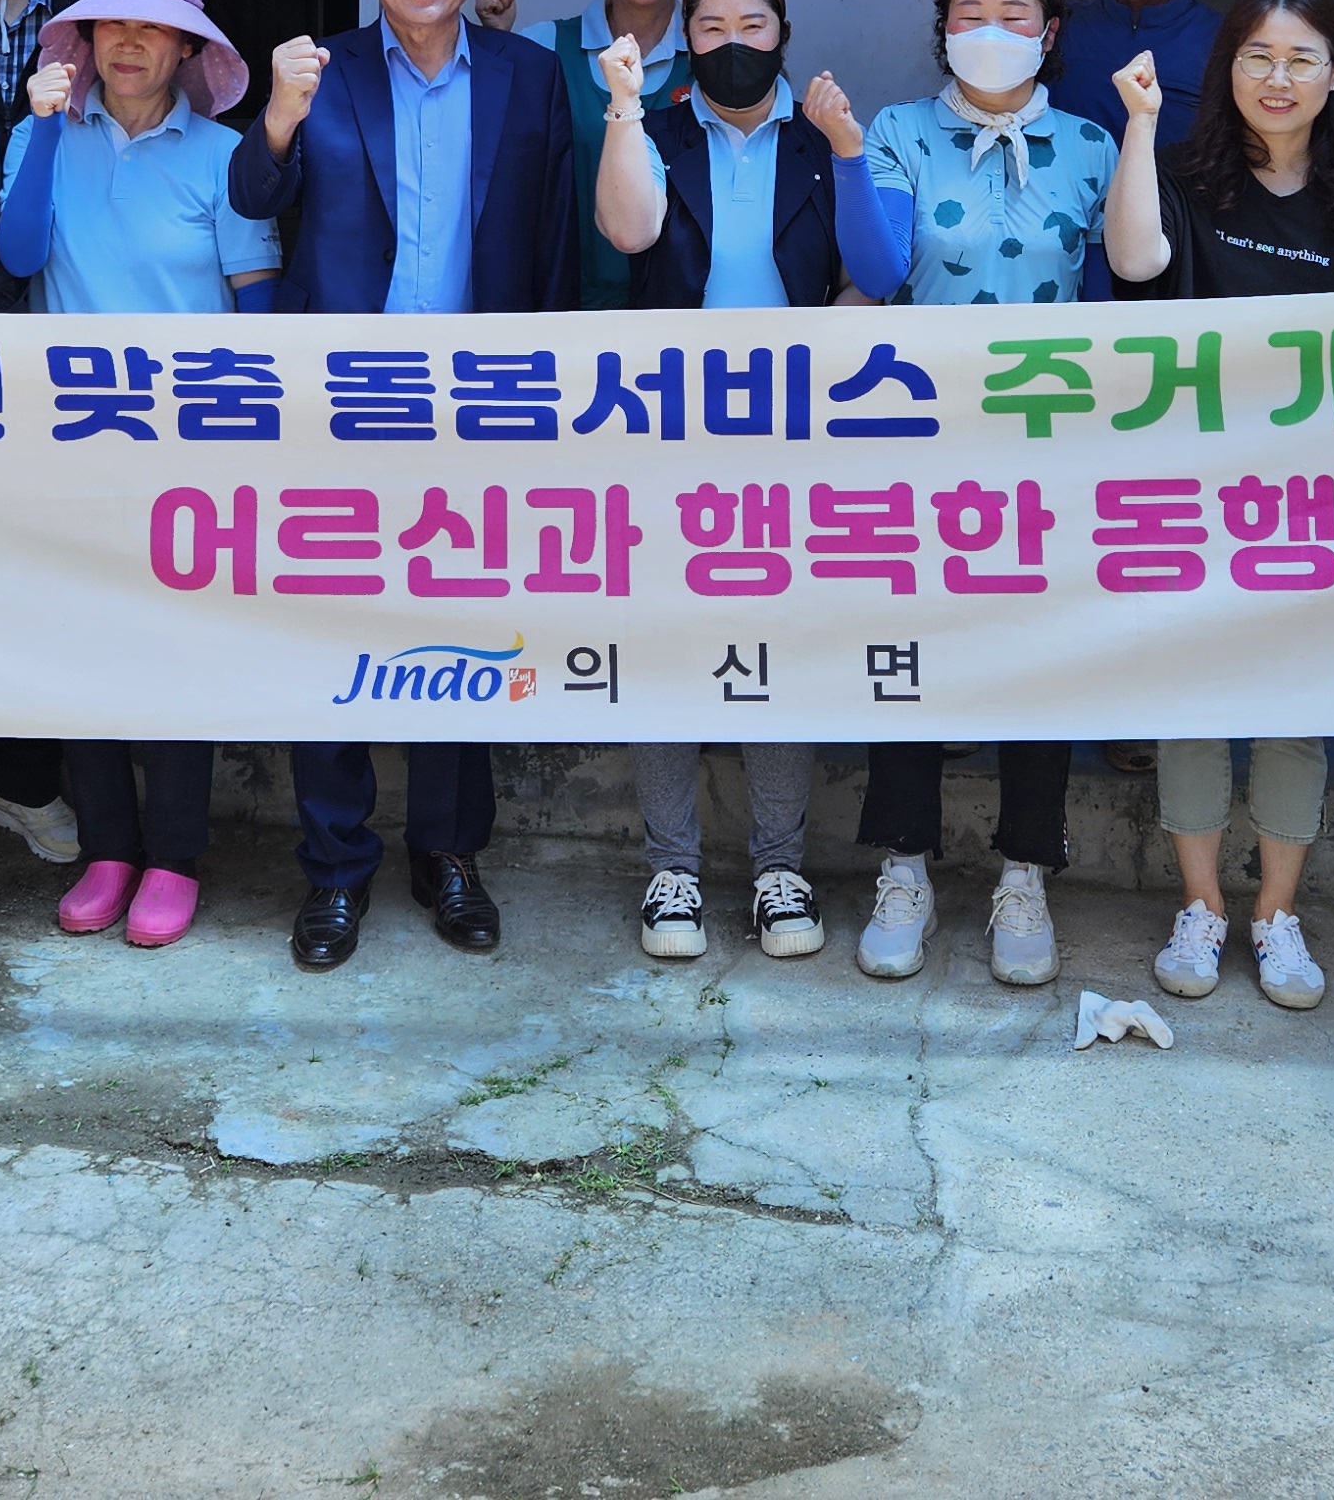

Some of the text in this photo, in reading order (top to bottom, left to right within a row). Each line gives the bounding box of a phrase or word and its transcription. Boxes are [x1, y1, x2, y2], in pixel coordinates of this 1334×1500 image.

[1255, 243, 1275, 254] see
[1276, 247, 1331, 267] anything
[45, 346, 285, 442] 맞춤
[323, 343, 941, 442] 돌봄서비스
[980, 331, 1226, 439] 주거
[149, 484, 644, 599] 어르신과
[674, 479, 1056, 598] 행복한
[332, 653, 503, 705] Jindo
